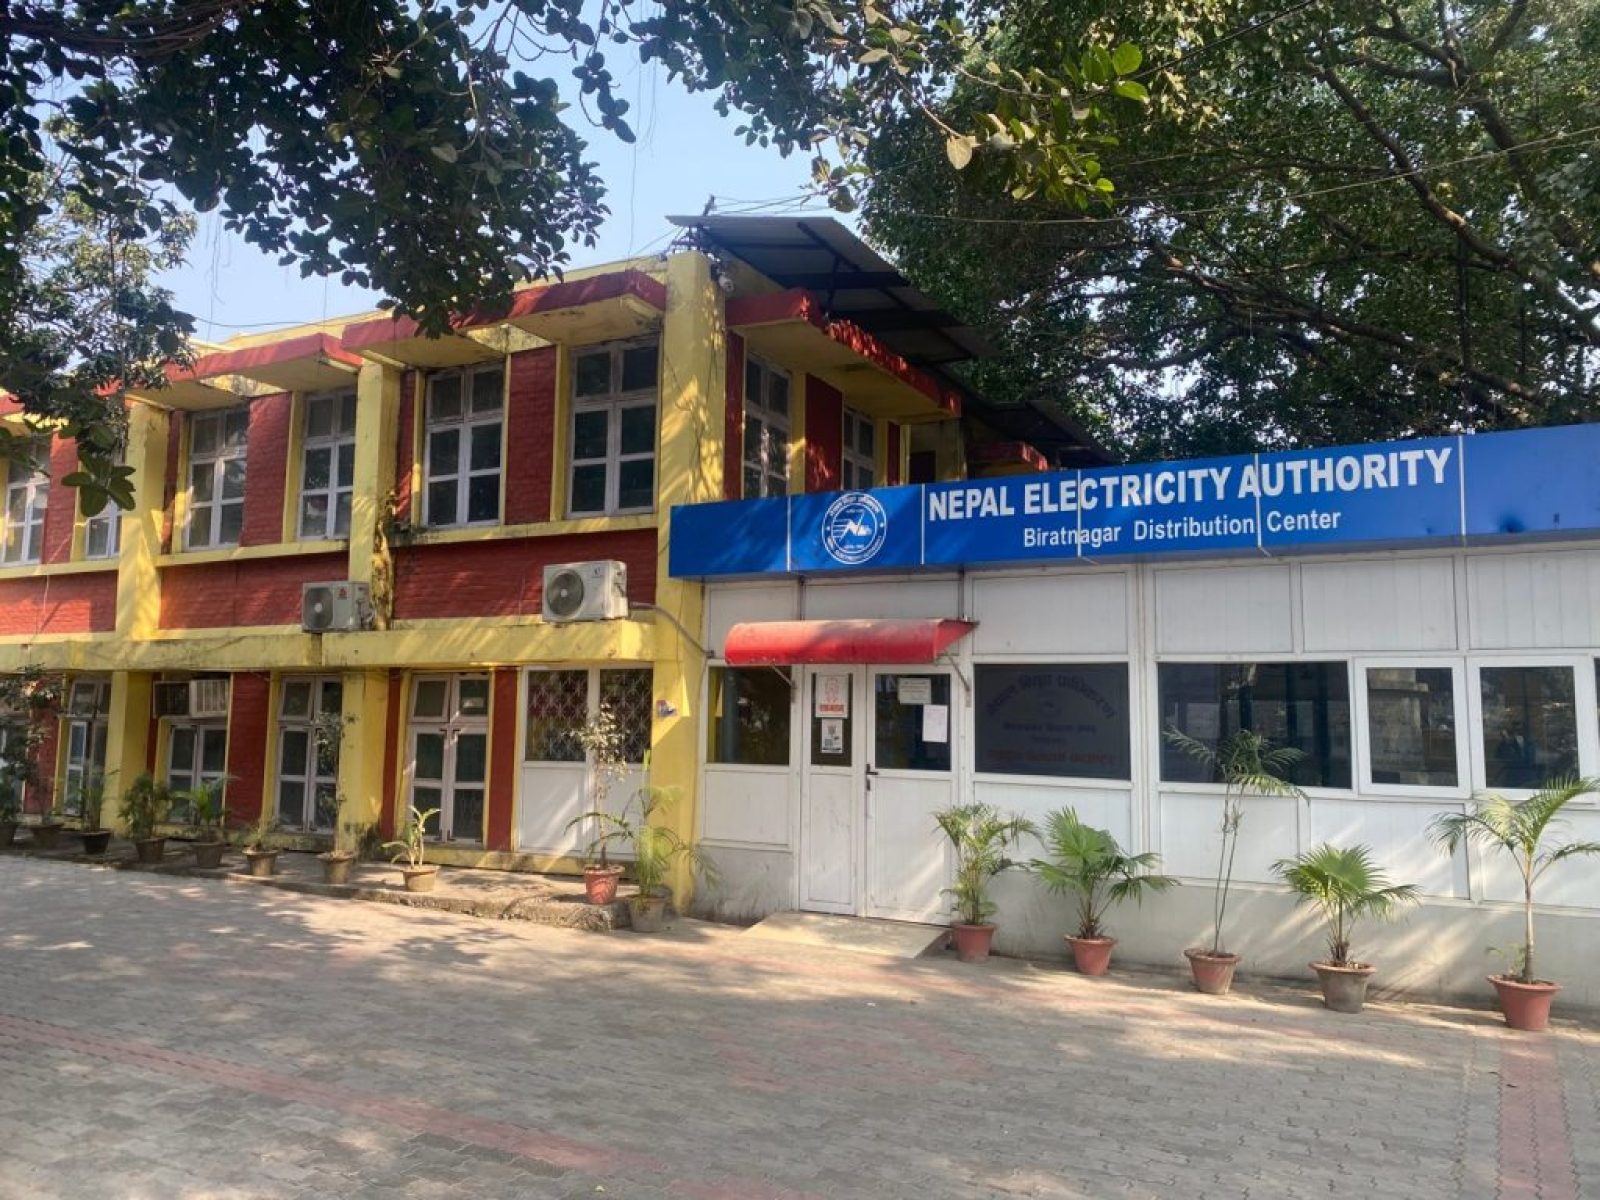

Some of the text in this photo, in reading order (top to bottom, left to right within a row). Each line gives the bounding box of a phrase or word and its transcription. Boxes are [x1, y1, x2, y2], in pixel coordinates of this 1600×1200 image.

[929, 486, 1015, 521] NEPAL
[1024, 467, 1232, 515] ELECTRICITY
[1237, 447, 1453, 499] AUTHORITY
[1024, 510, 1342, 548] Biratnagar Distribution Center
